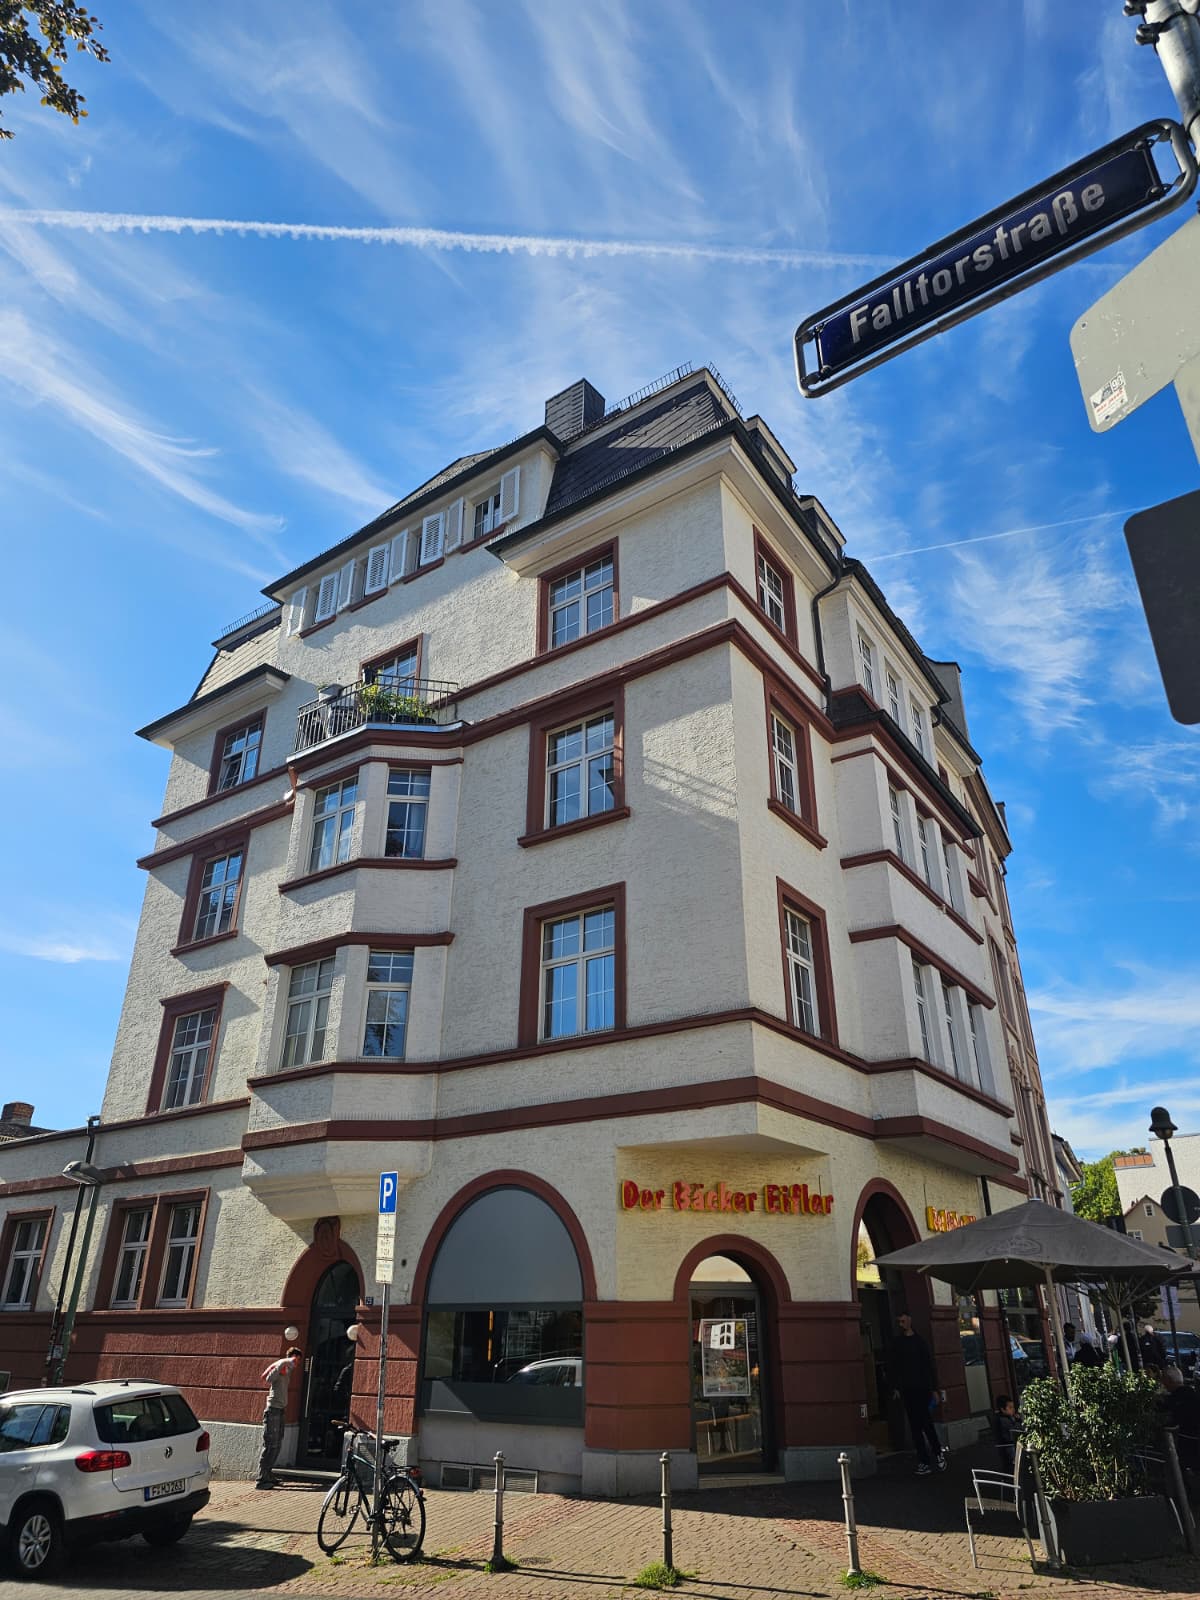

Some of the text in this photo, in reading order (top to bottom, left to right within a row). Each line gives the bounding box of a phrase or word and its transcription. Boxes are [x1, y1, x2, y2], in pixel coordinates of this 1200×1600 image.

[848, 181, 1106, 344] Falltorstraße
[382, 1177, 394, 1209] P
[621, 1180, 834, 1215] Der Bäcker Eifler
